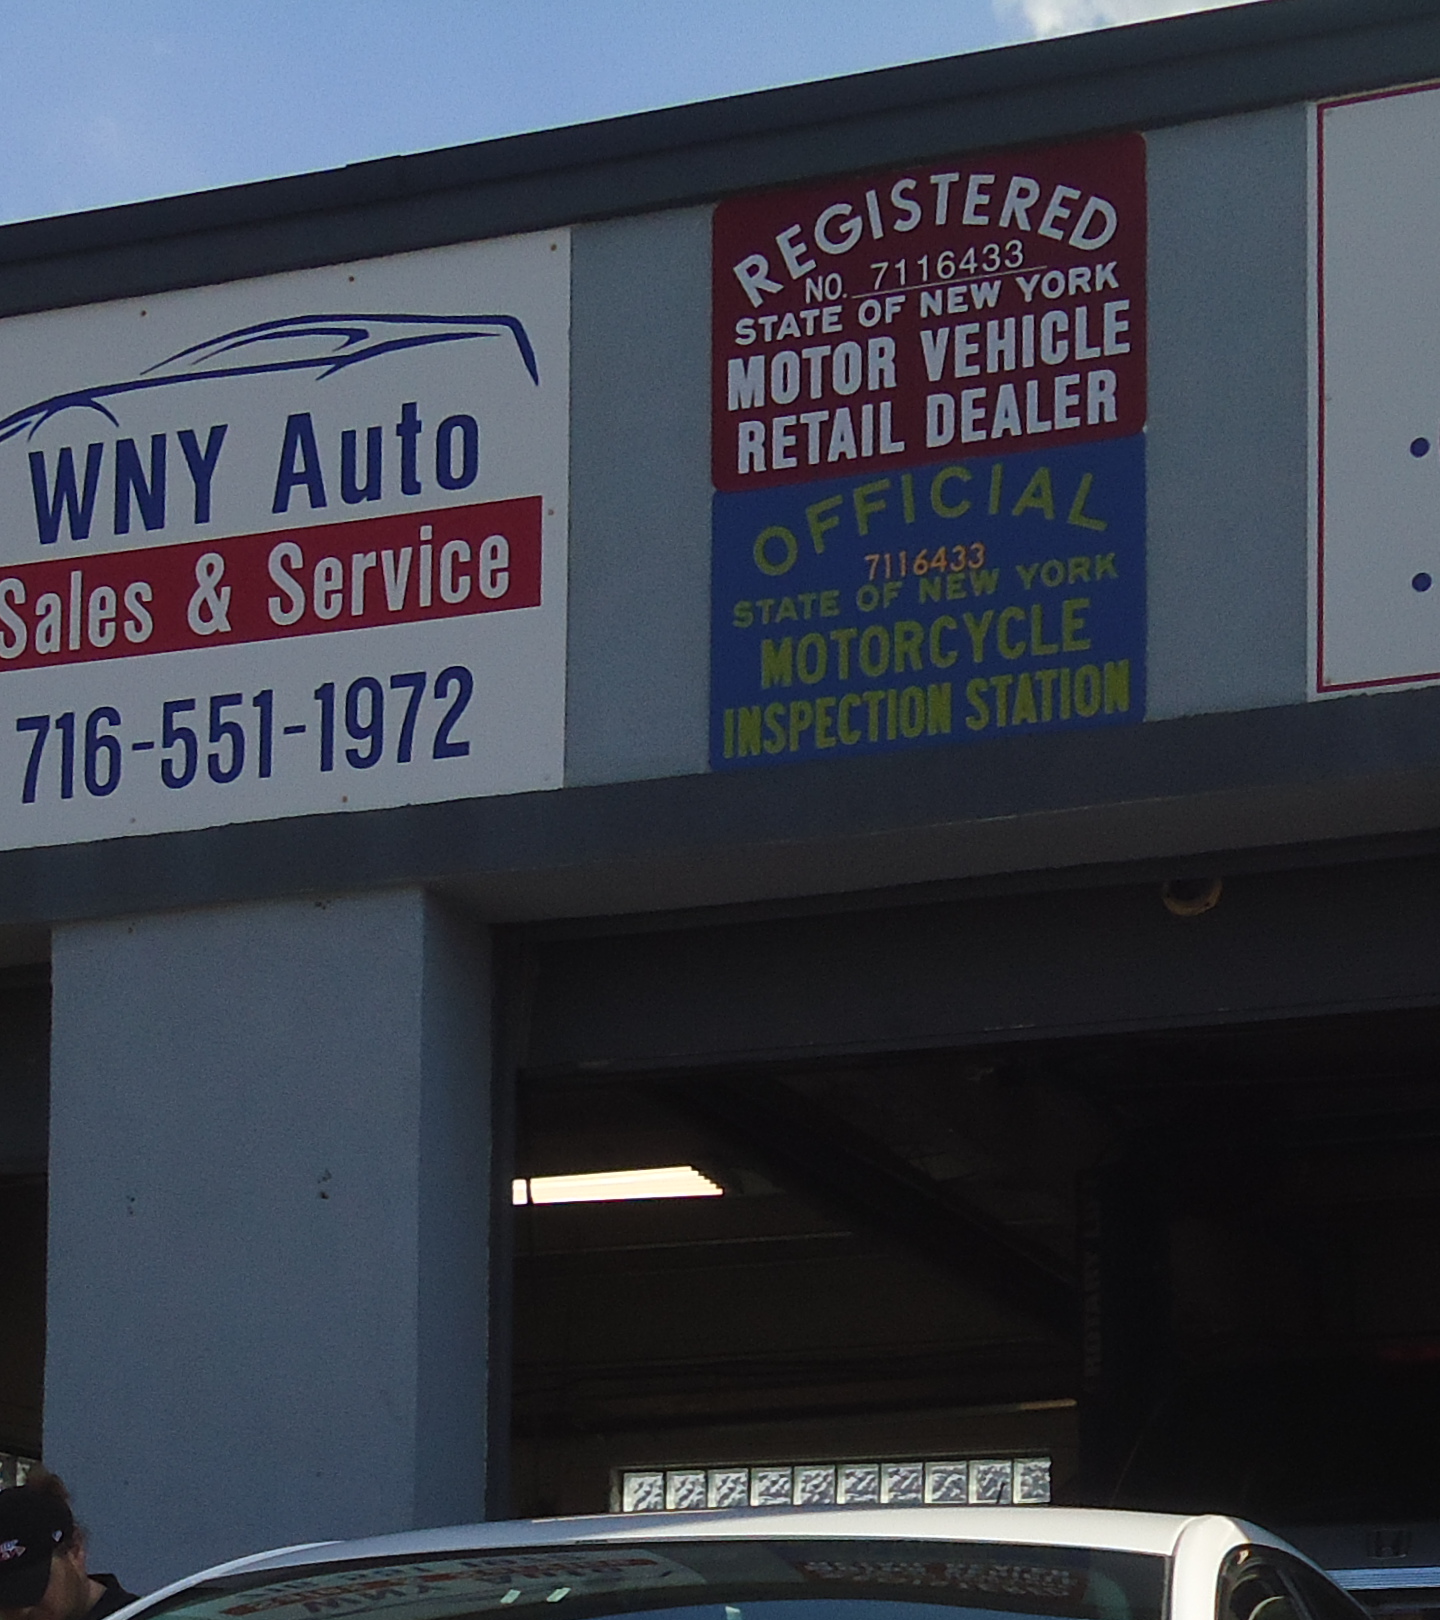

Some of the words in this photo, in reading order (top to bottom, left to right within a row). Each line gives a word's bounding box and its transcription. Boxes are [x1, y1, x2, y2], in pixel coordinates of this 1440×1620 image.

[733, 172, 1118, 308] REGISTERED
[871, 239, 1025, 290] 7116433
[727, 336, 897, 412] MOTOR
[920, 299, 1131, 382] VEHICLE
[735, 304, 843, 346] STATE
[858, 294, 907, 329] OF
[920, 280, 1002, 318] NEW
[1016, 261, 1119, 301] YORK
[27, 423, 229, 545] WNY
[272, 402, 480, 514] Auto
[737, 402, 905, 474] RETAIL
[925, 369, 1118, 449] DEALER
[752, 463, 1109, 576] OFFICIAL
[864, 542, 986, 581] 7116433
[187, 552, 232, 636] &
[267, 523, 510, 626] Service
[733, 588, 840, 630] STATE
[856, 579, 903, 613] OF
[919, 566, 1000, 603] NEW
[1015, 552, 1119, 588] YORK
[761, 598, 1092, 690] MOTORCYCLE
[16, 664, 474, 804] 716-551-1972
[723, 682, 952, 760] INSPECTION
[965, 658, 1132, 731] STATION
